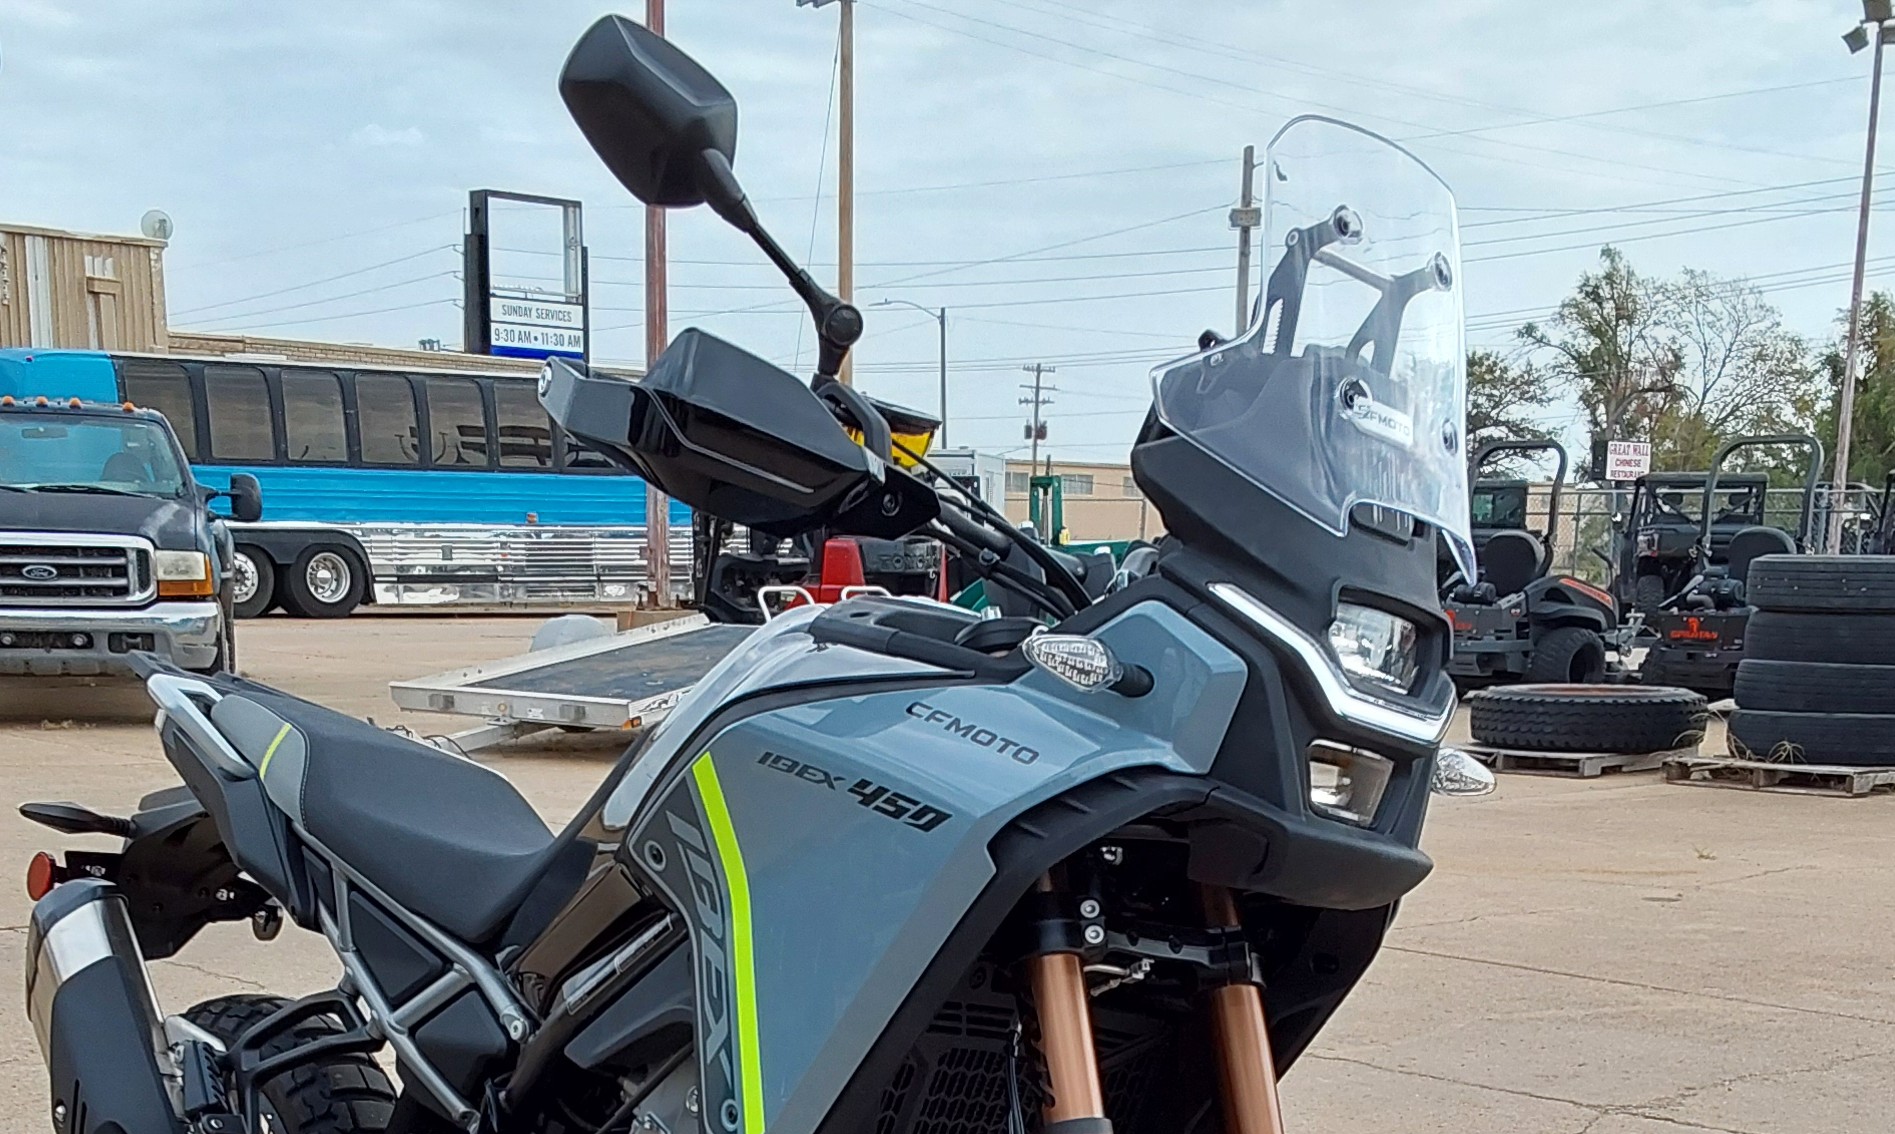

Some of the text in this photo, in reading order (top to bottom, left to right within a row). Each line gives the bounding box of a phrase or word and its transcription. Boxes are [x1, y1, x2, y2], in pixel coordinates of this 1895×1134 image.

[501, 304, 572, 322] SUNDAY SERVICES
[494, 328, 581, 348] 9:30 AM 11:30 AM
[1614, 458, 1642, 468] CHINESE
[905, 701, 1041, 766] CFMOTO
[756, 751, 953, 833] IBEX 450
[665, 810, 733, 1092] IBEX
